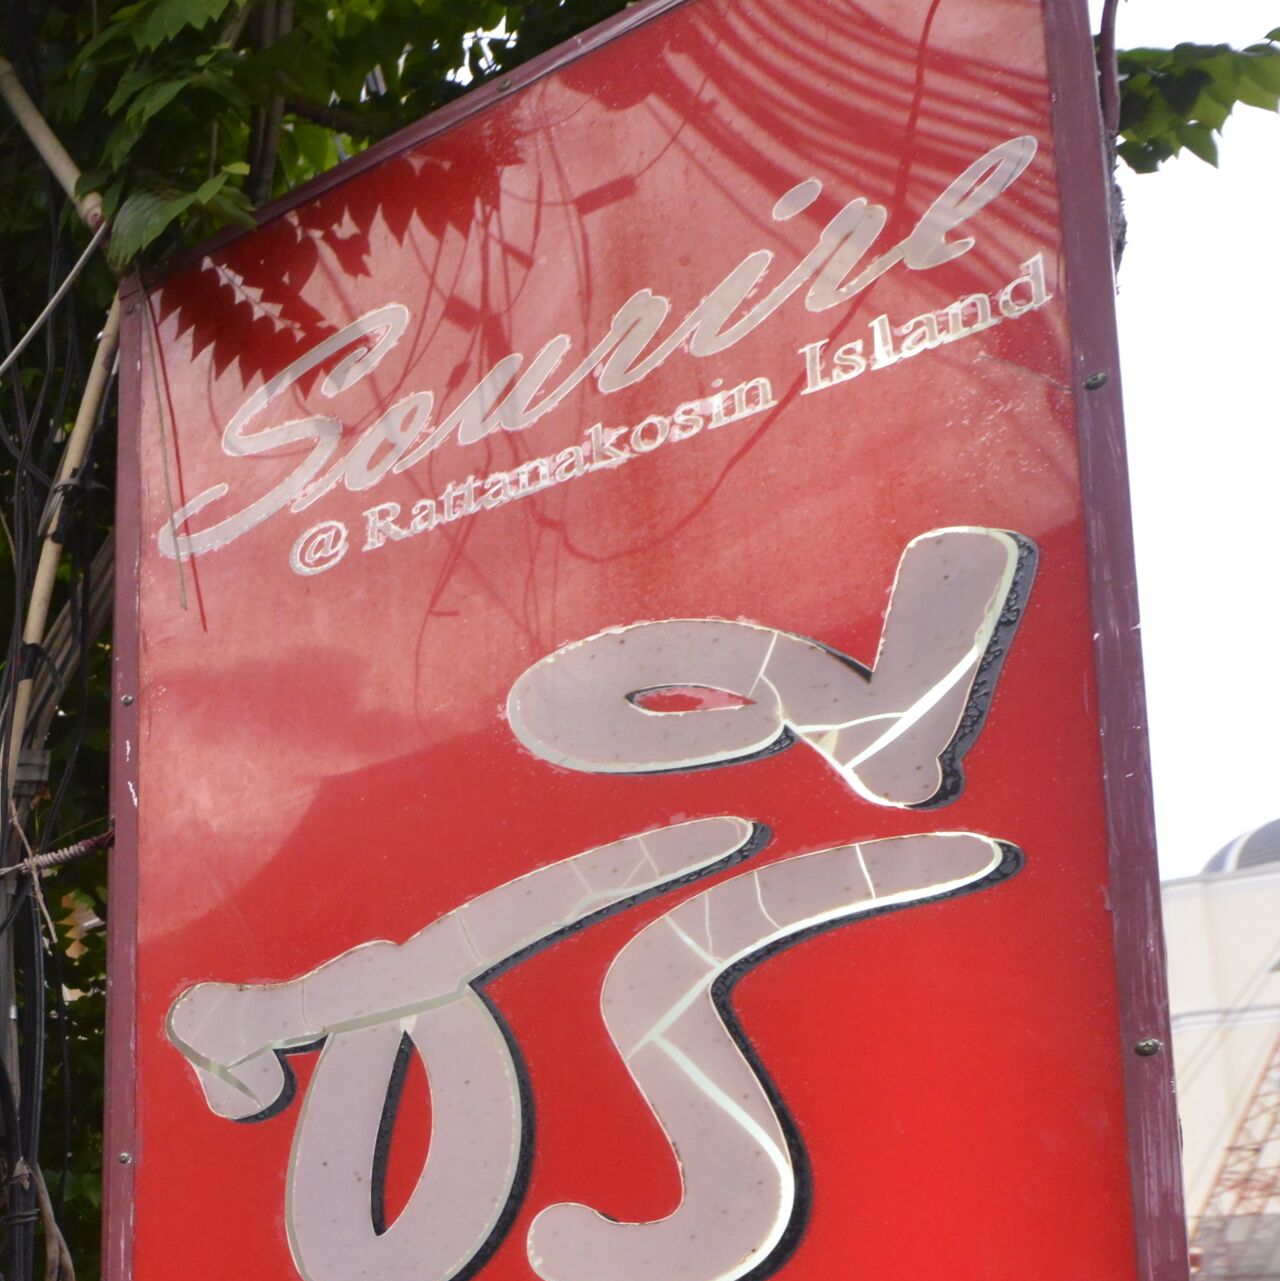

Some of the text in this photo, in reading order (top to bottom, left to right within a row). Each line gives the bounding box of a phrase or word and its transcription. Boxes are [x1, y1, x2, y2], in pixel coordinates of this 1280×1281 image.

[289, 251, 1053, 576] @ Rattanakosin Island
